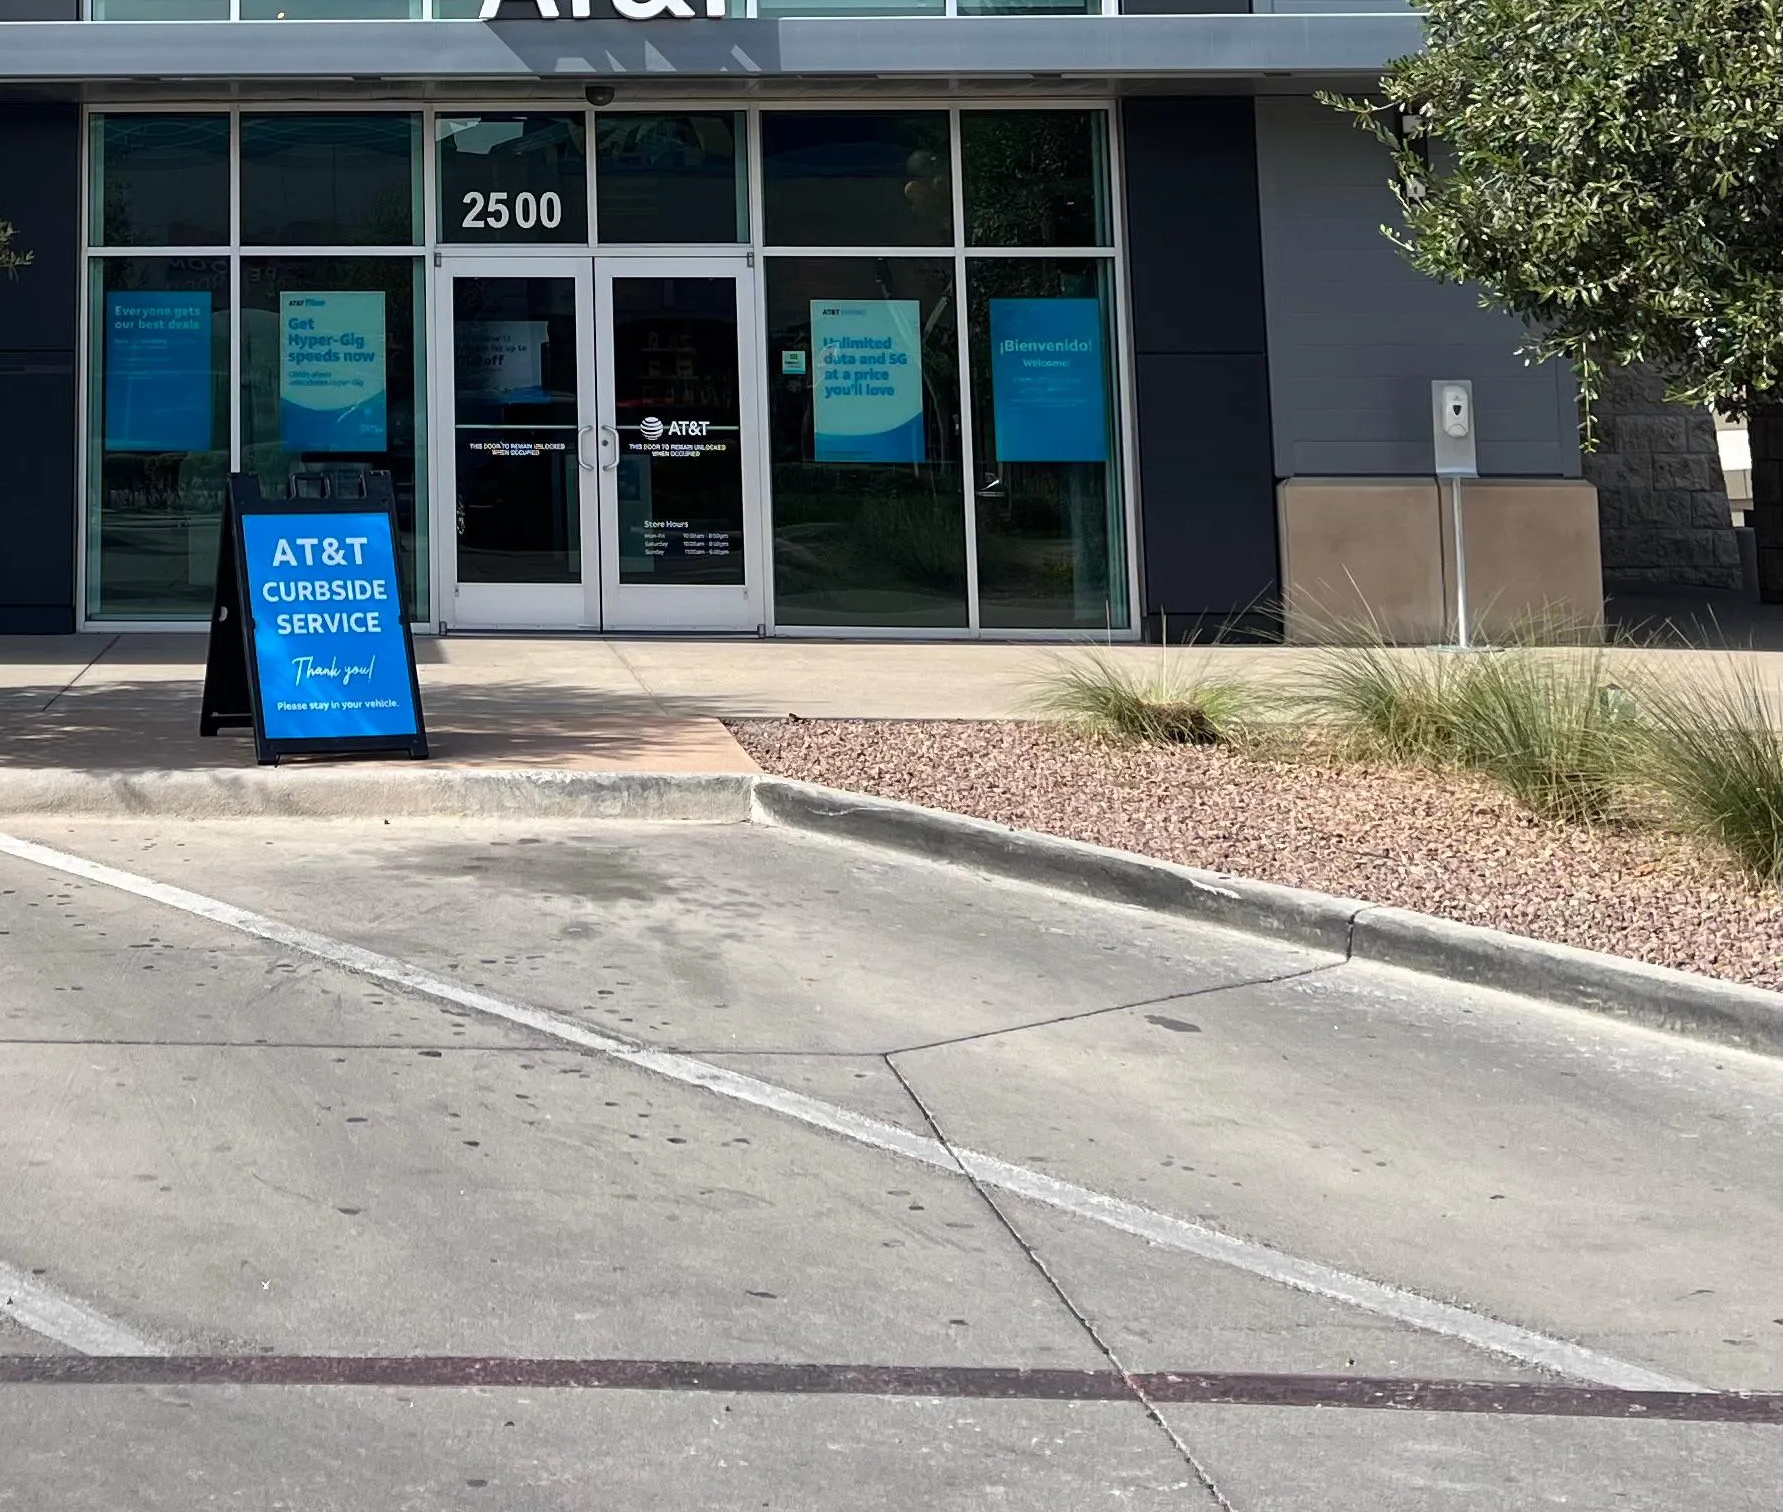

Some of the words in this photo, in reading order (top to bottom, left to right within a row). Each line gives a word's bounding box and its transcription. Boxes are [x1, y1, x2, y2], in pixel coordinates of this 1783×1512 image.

[461, 191, 562, 228] 2500
[115, 306, 171, 319] Everyone
[174, 306, 201, 319] gets
[822, 308, 840, 316] AT&T
[114, 321, 134, 329] our
[138, 319, 165, 329] best
[168, 319, 200, 329] deals
[288, 317, 315, 330] Get
[288, 333, 365, 349] Hyper-Gig
[823, 337, 892, 349] Unlimited
[999, 339, 1092, 355] ¡Bienvenido!
[288, 349, 341, 365] speeds
[343, 352, 376, 363] now
[484, 354, 505, 366] off
[824, 353, 856, 365] data
[859, 353, 886, 365] and
[889, 353, 908, 365] 5G
[825, 369, 839, 380] at
[843, 371, 851, 380] a
[854, 368, 889, 383] price
[824, 384, 862, 399] you'll
[866, 384, 895, 396] love
[668, 421, 710, 436] AT&T
[644, 520, 665, 528] Store
[665, 520, 689, 528] Hours
[272, 537, 368, 566] AT&T
[262, 579, 387, 602] CURBSIDE
[277, 612, 381, 635] SERVICE
[291, 656, 341, 686] Thank
[343, 655, 375, 685] you!
[277, 701, 308, 711] Please
[309, 701, 330, 712] stay
[331, 700, 340, 710] in
[341, 702, 363, 712] your
[365, 699, 399, 708] vehicle.
